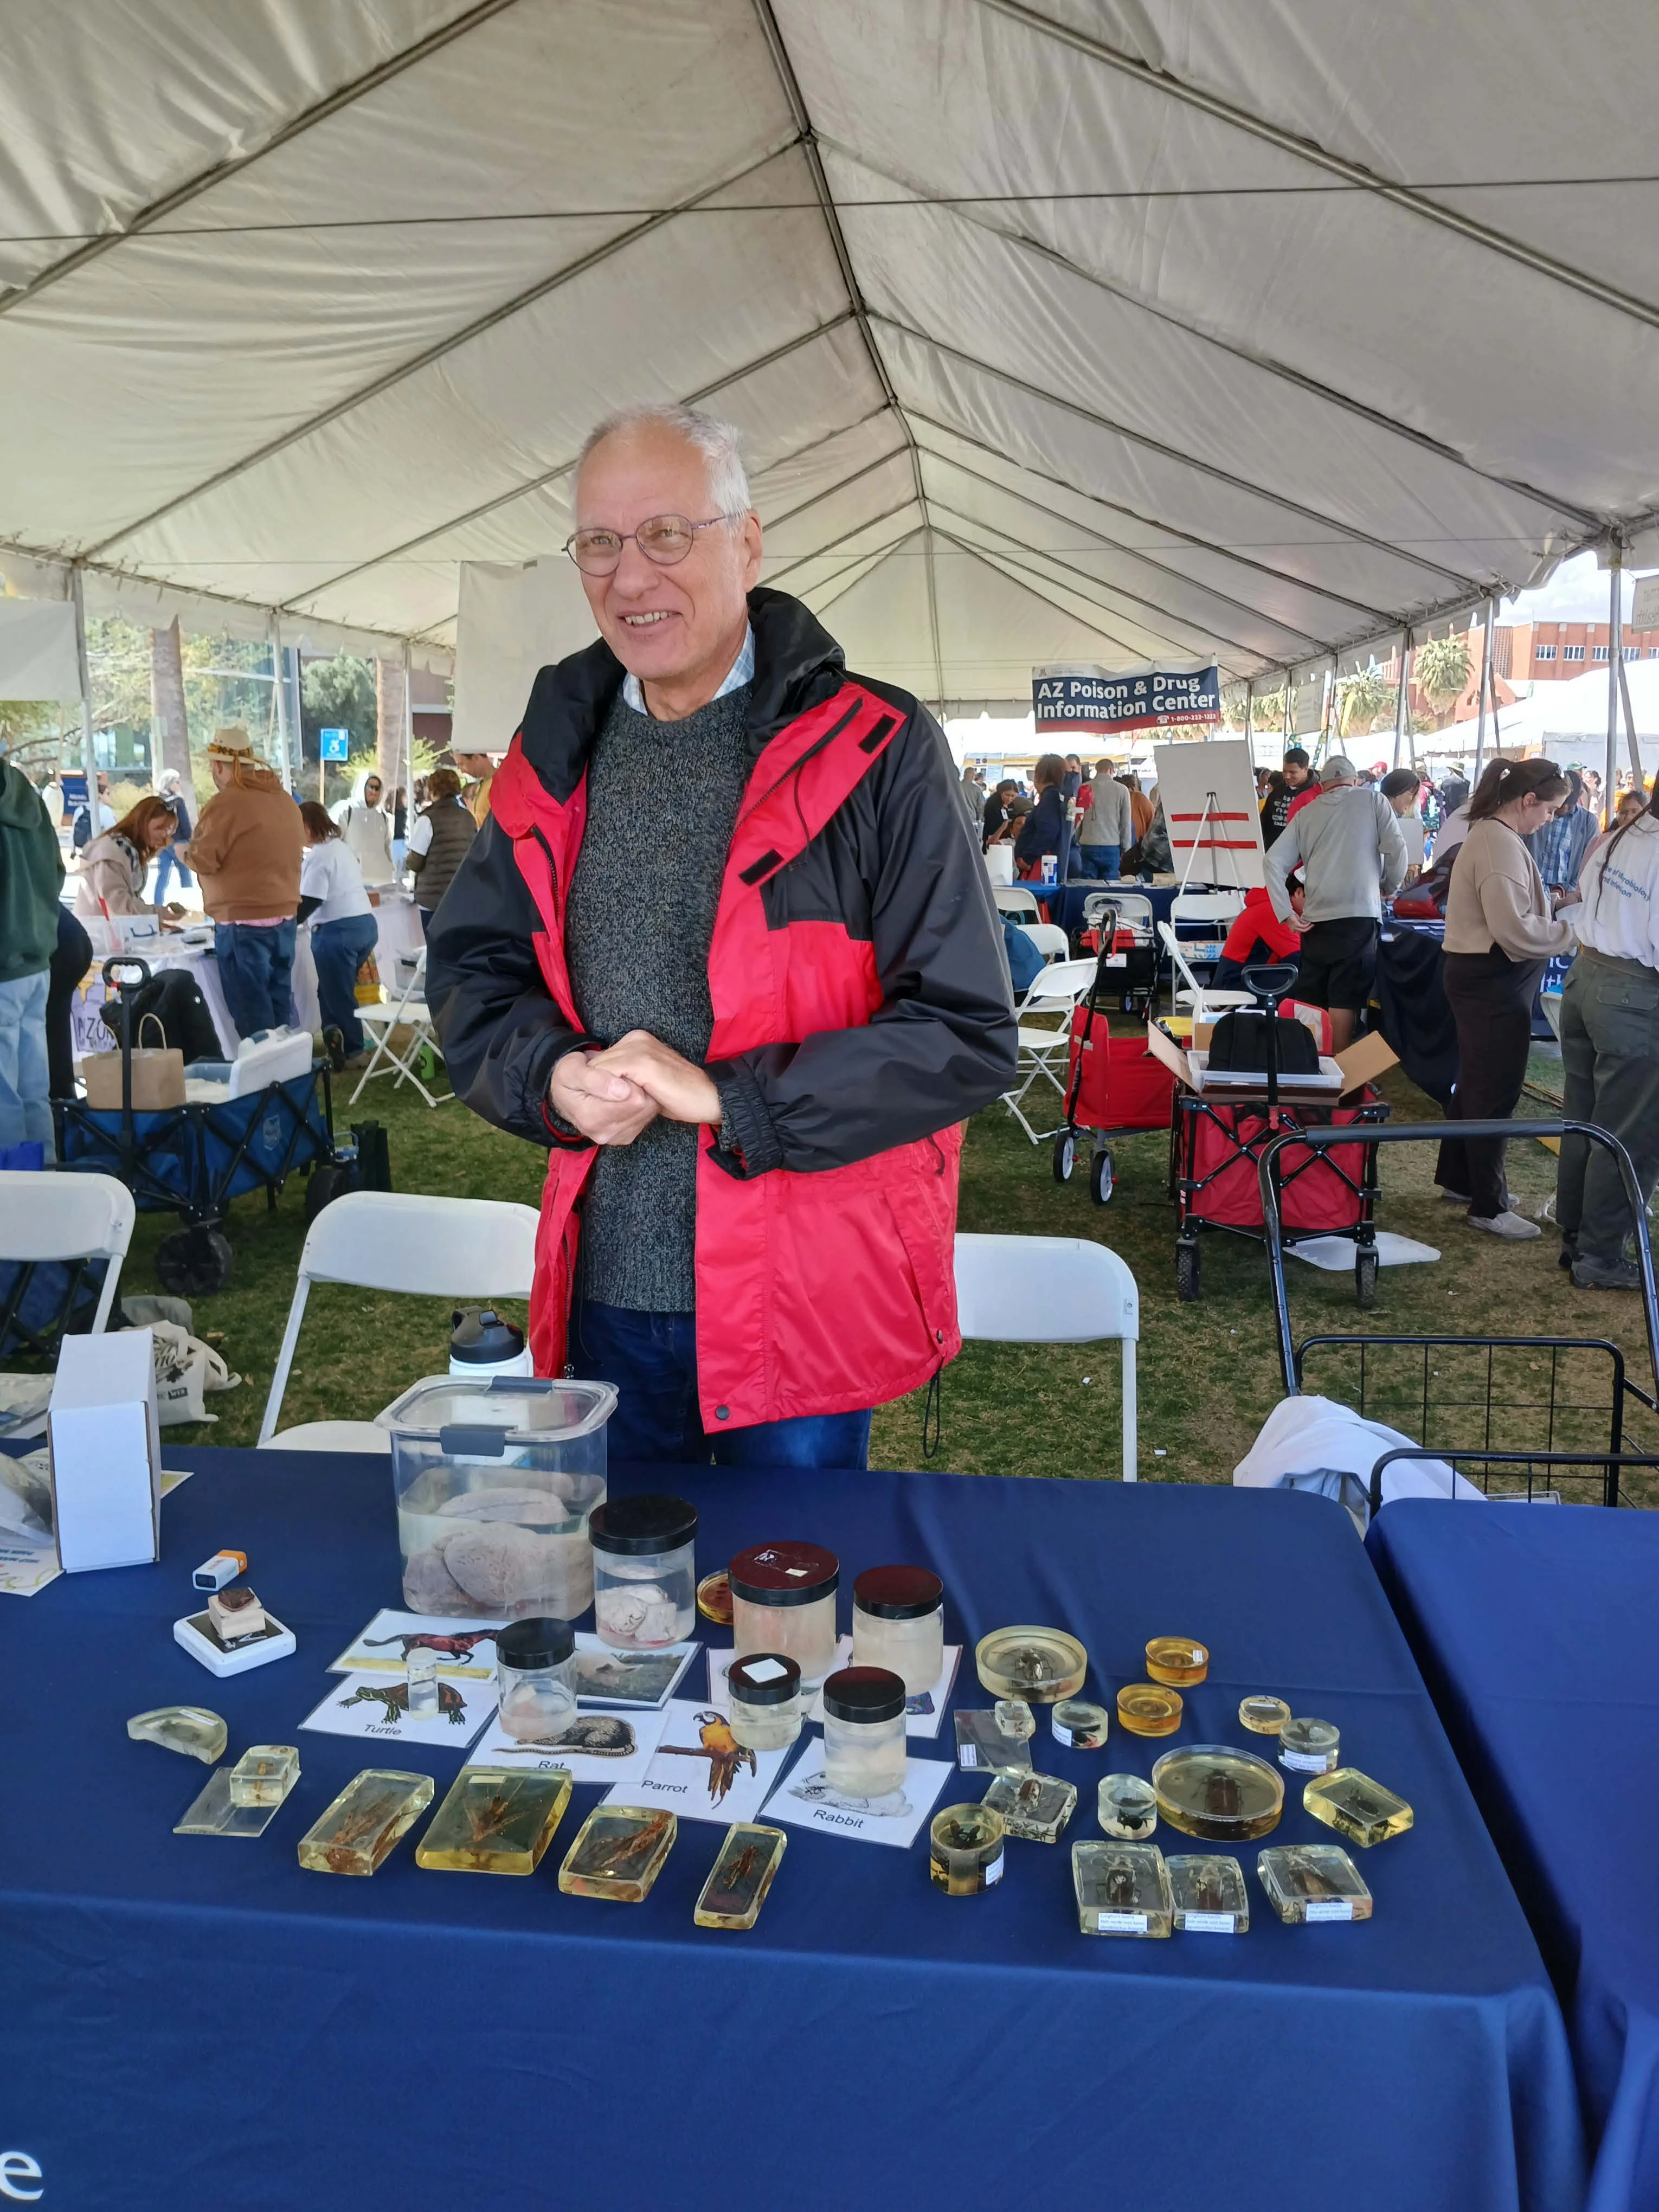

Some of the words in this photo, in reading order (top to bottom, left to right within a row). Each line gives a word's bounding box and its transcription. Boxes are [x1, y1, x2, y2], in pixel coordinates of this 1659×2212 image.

[1038, 681, 1064, 699] AZ
[1070, 680, 1128, 699] Poison
[1134, 681, 1147, 696] &
[1153, 676, 1200, 692] Drug
[1037, 700, 1146, 719] Information
[1152, 692, 1215, 711] Center
[364, 1724, 402, 1735] Turtle
[538, 1760, 565, 1770] Rat
[641, 1780, 687, 1793] Parrot
[813, 1809, 864, 1828] Rabbit
